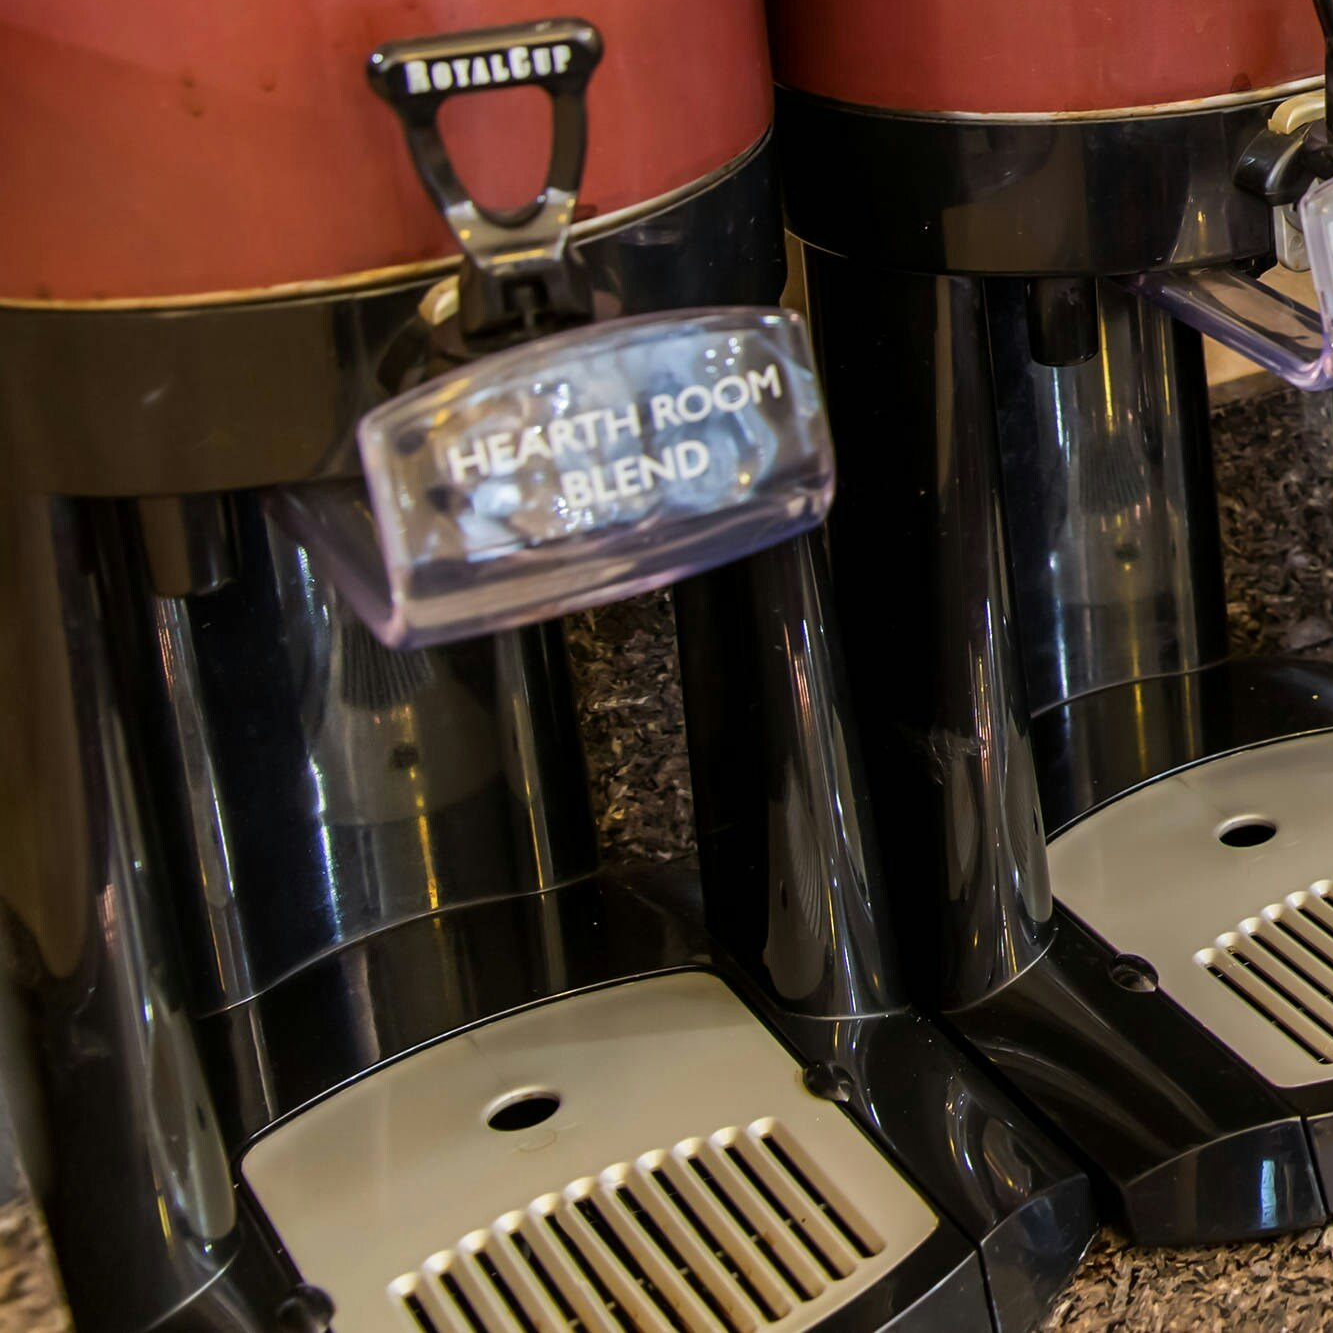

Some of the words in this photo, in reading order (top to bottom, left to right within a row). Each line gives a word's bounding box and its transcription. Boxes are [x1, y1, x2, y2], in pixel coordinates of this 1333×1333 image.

[446, 402, 641, 482] HEARTH
[651, 363, 784, 434] ROOM
[560, 438, 711, 509] BLEND
